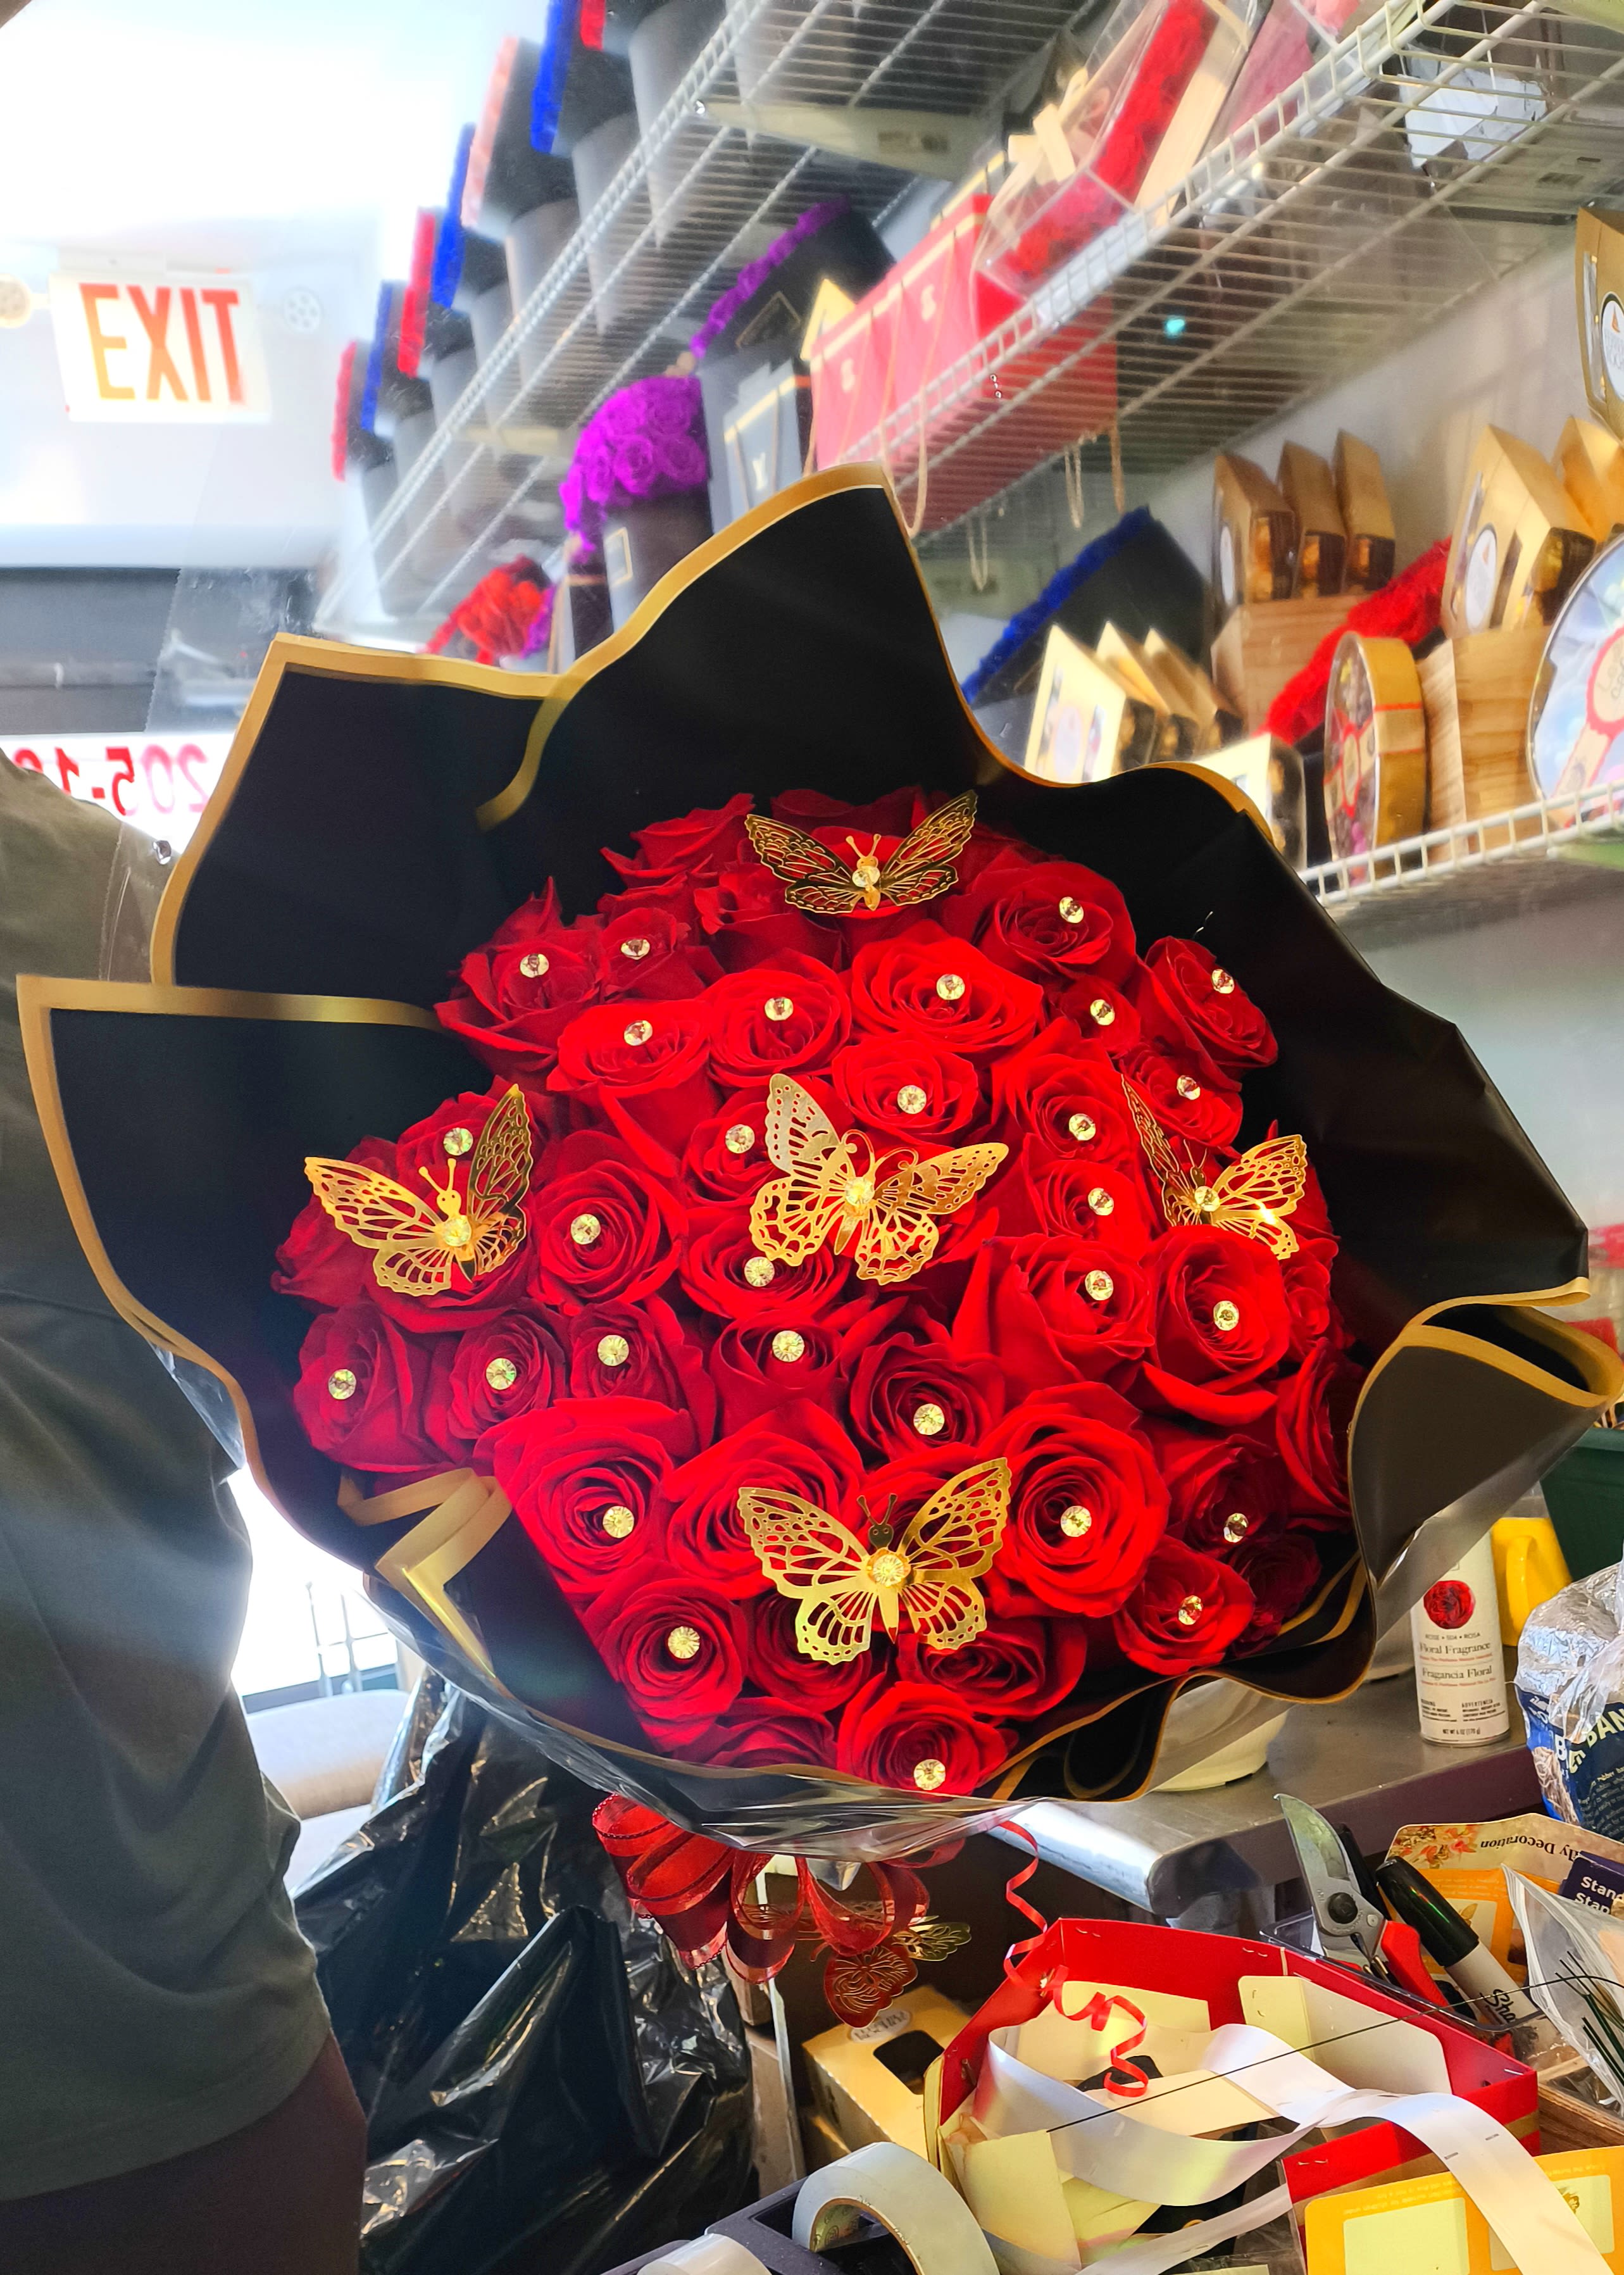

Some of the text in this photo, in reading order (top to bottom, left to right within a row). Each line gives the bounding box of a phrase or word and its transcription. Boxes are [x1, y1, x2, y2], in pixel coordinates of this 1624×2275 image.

[79, 282, 246, 405] EXIT
[1420, 1642, 1491, 1656] Floral Fragrance
[1422, 1665, 1492, 1681] Fragancia Floral
[1480, 1835, 1556, 1855] Decoration
